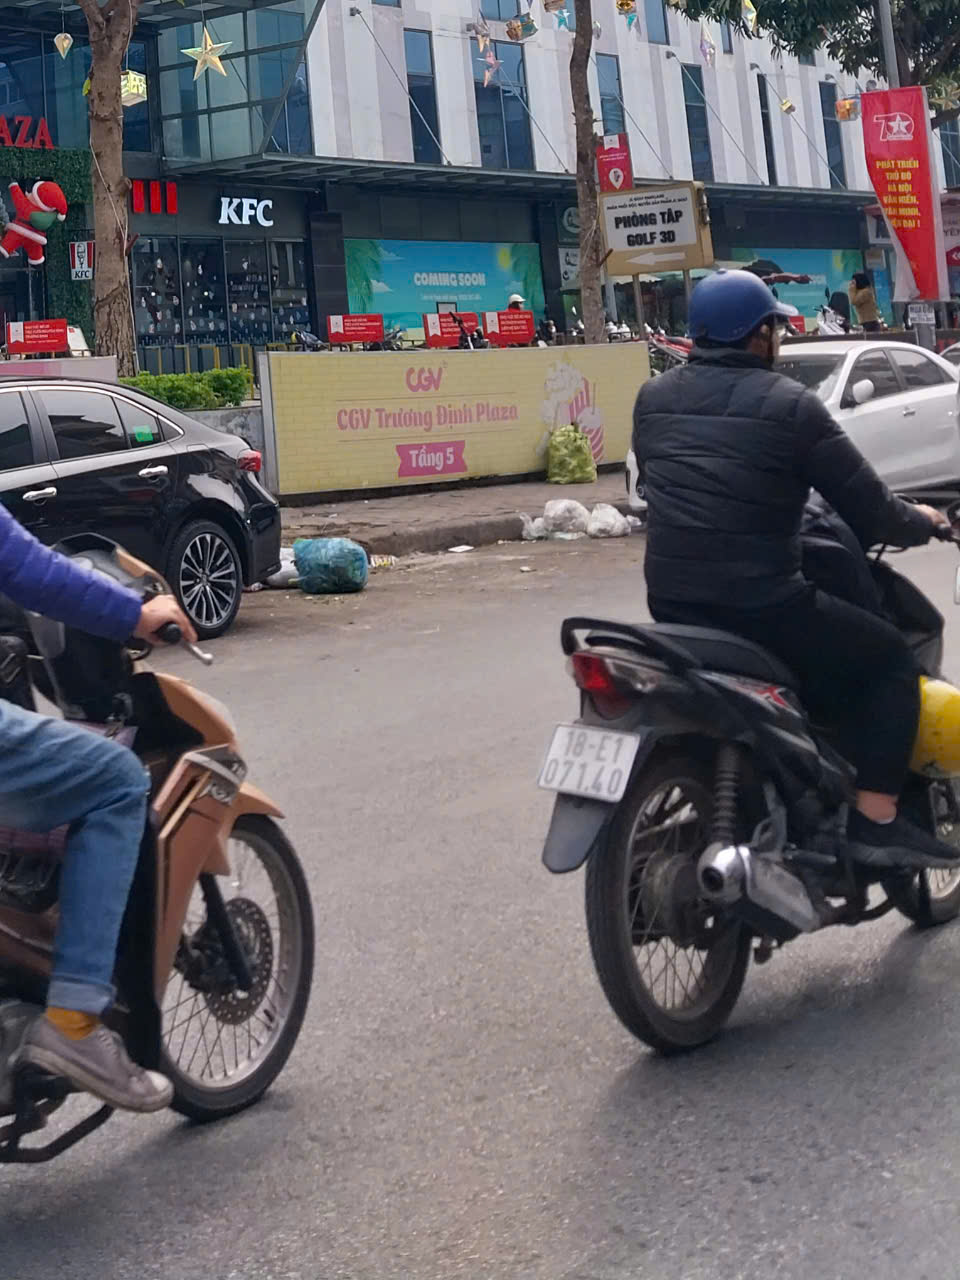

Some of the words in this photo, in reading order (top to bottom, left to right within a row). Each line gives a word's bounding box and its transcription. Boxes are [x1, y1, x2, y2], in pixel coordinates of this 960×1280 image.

[218, 196, 274, 227] KFC
[615, 211, 657, 229] PHÒNG
[627, 231, 656, 247] GOLF
[659, 230, 675, 243] 3D
[74, 270, 91, 279] KFC
[414, 272, 457, 286] COMING
[458, 272, 486, 286] SOON
[406, 367, 443, 392] CGV
[336, 408, 371, 431] CGV
[375, 407, 433, 432] Trương
[436, 402, 472, 430] Định
[476, 401, 519, 423] Plaza
[409, 445, 444, 471] Tầng
[446, 447, 455, 465] 5
[564, 730, 624, 763] 18-E1
[544, 758, 623, 795] 071.40
